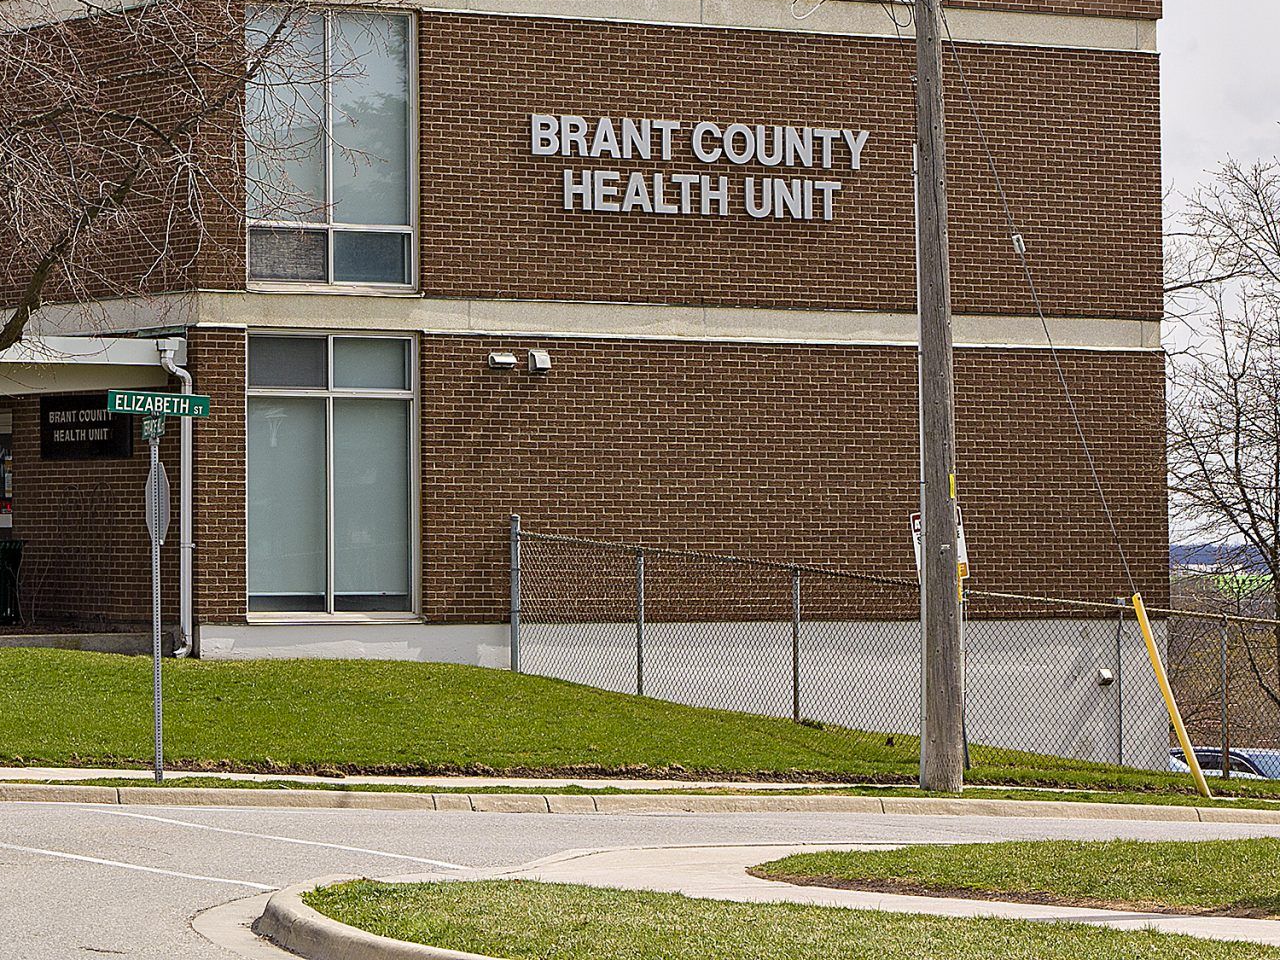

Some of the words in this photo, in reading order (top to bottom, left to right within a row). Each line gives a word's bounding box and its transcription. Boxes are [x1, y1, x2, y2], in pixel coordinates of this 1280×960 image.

[530, 113, 681, 161] BRANT
[691, 121, 870, 171] COUNTY
[563, 168, 729, 217] HEALTH
[743, 176, 842, 222] UNIT
[115, 394, 190, 414] ELIZABETH
[193, 406, 204, 415] ST
[48, 410, 77, 424] BRANT
[53, 429, 86, 442] HEALTH
[88, 428, 109, 441] UNIT
